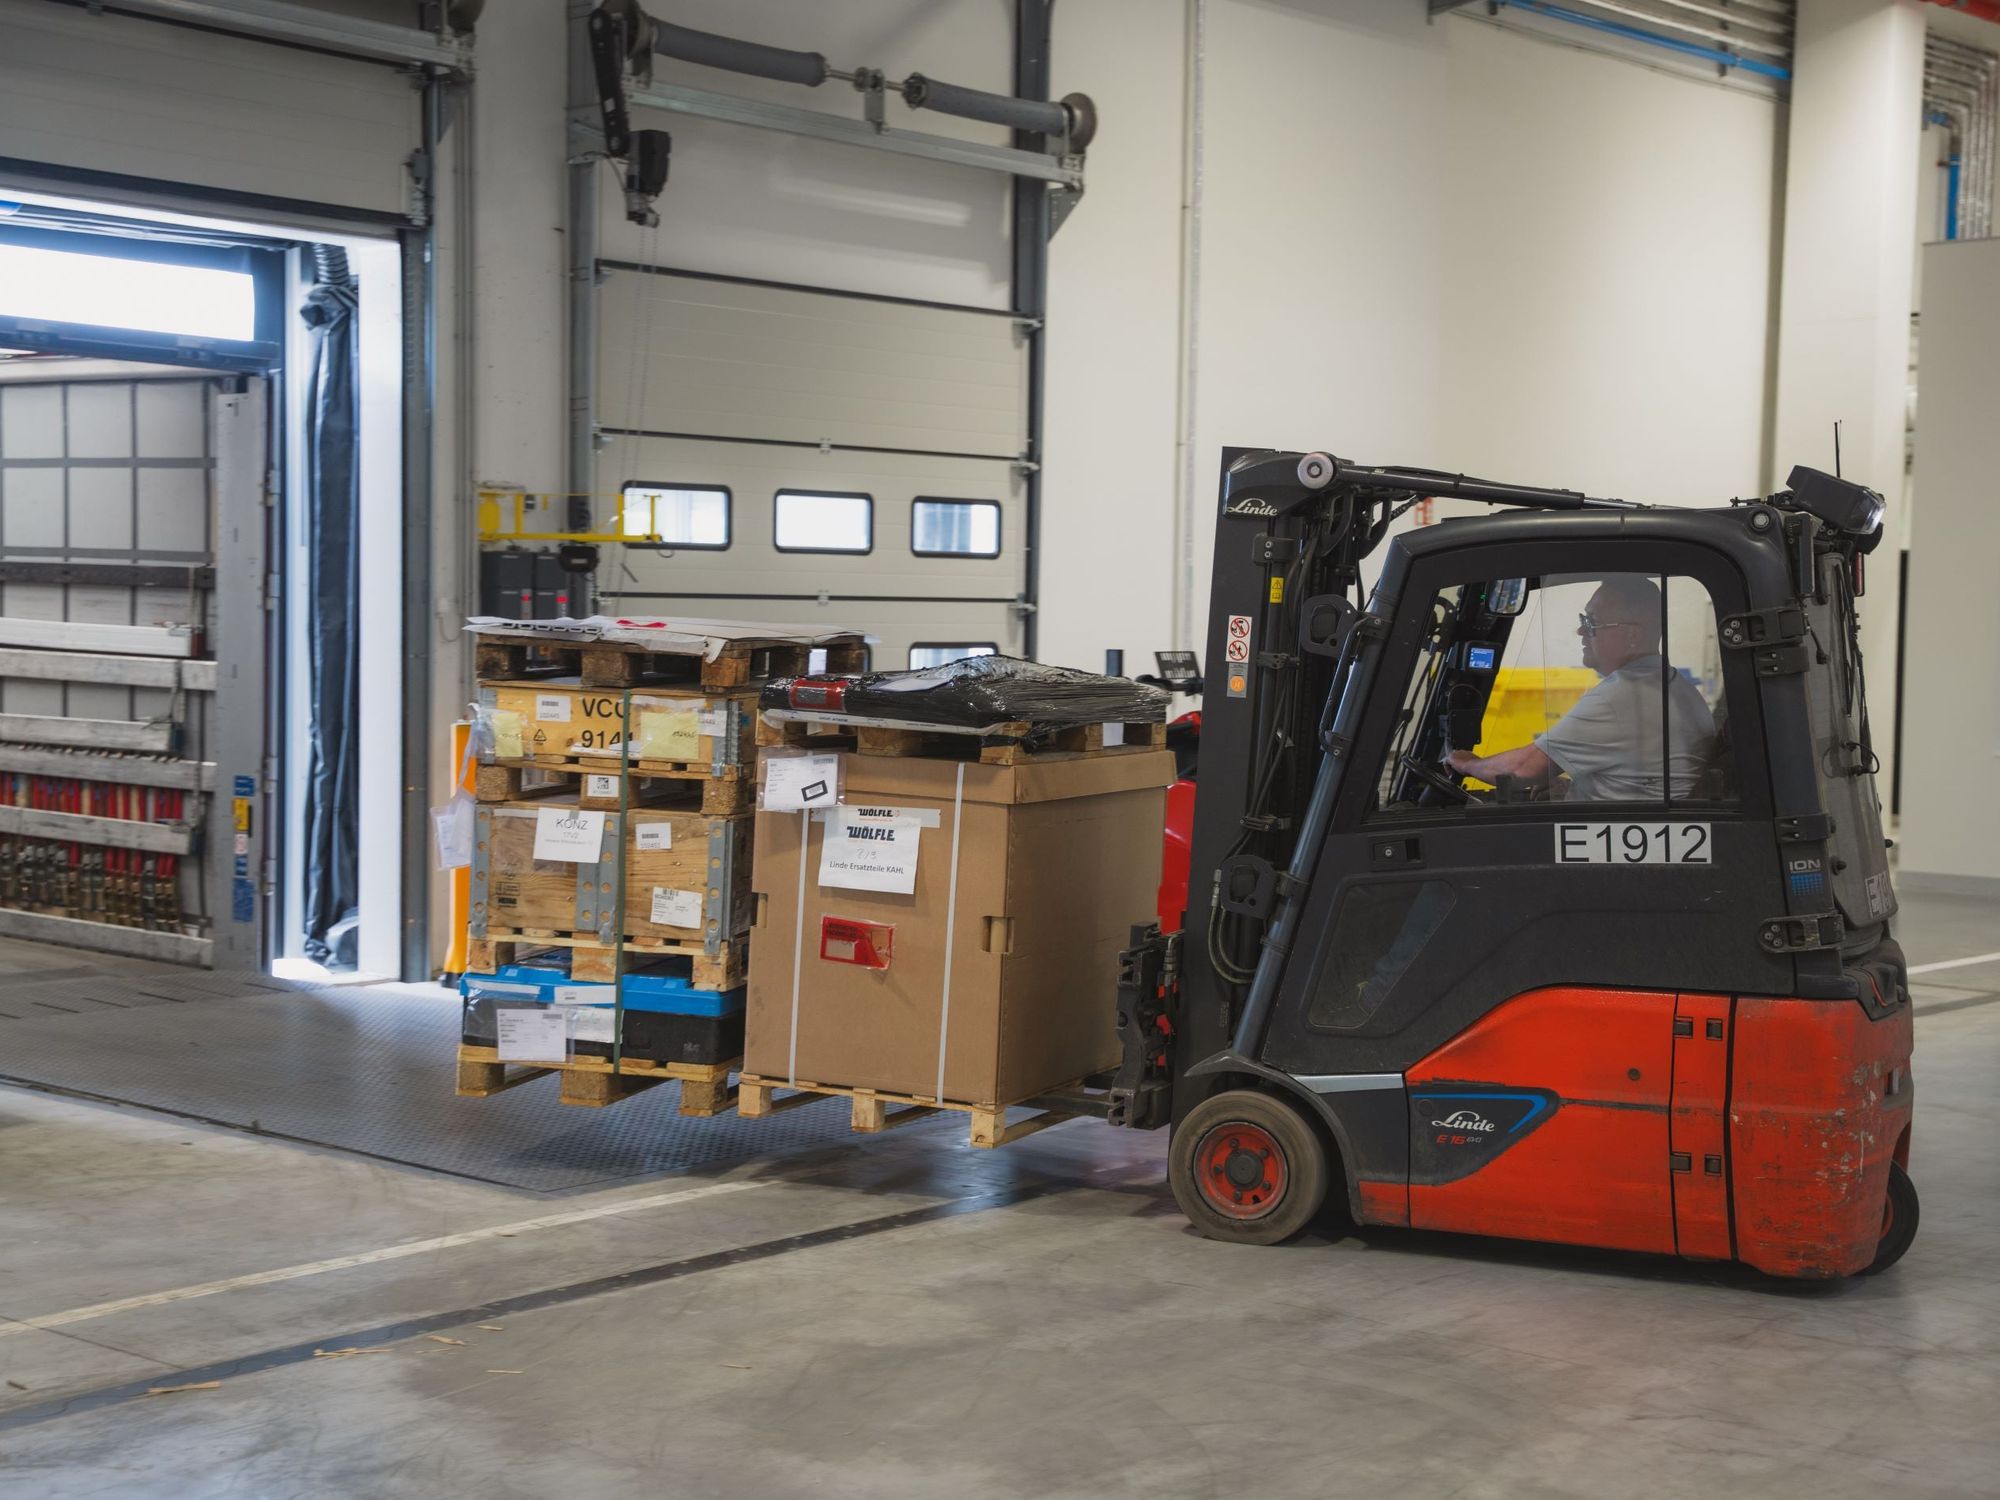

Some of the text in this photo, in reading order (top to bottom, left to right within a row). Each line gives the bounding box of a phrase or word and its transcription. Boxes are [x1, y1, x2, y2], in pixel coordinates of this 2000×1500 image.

[1226, 498, 1278, 516] Linde
[581, 730, 633, 748] 914
[847, 825, 895, 841] WÖLFLE
[1560, 825, 1707, 863] E1912
[829, 861, 849, 869] Linde
[849, 862, 885, 873] Ersatzteile
[1788, 859, 1820, 871] ION
[1432, 1111, 1495, 1132] Linde
